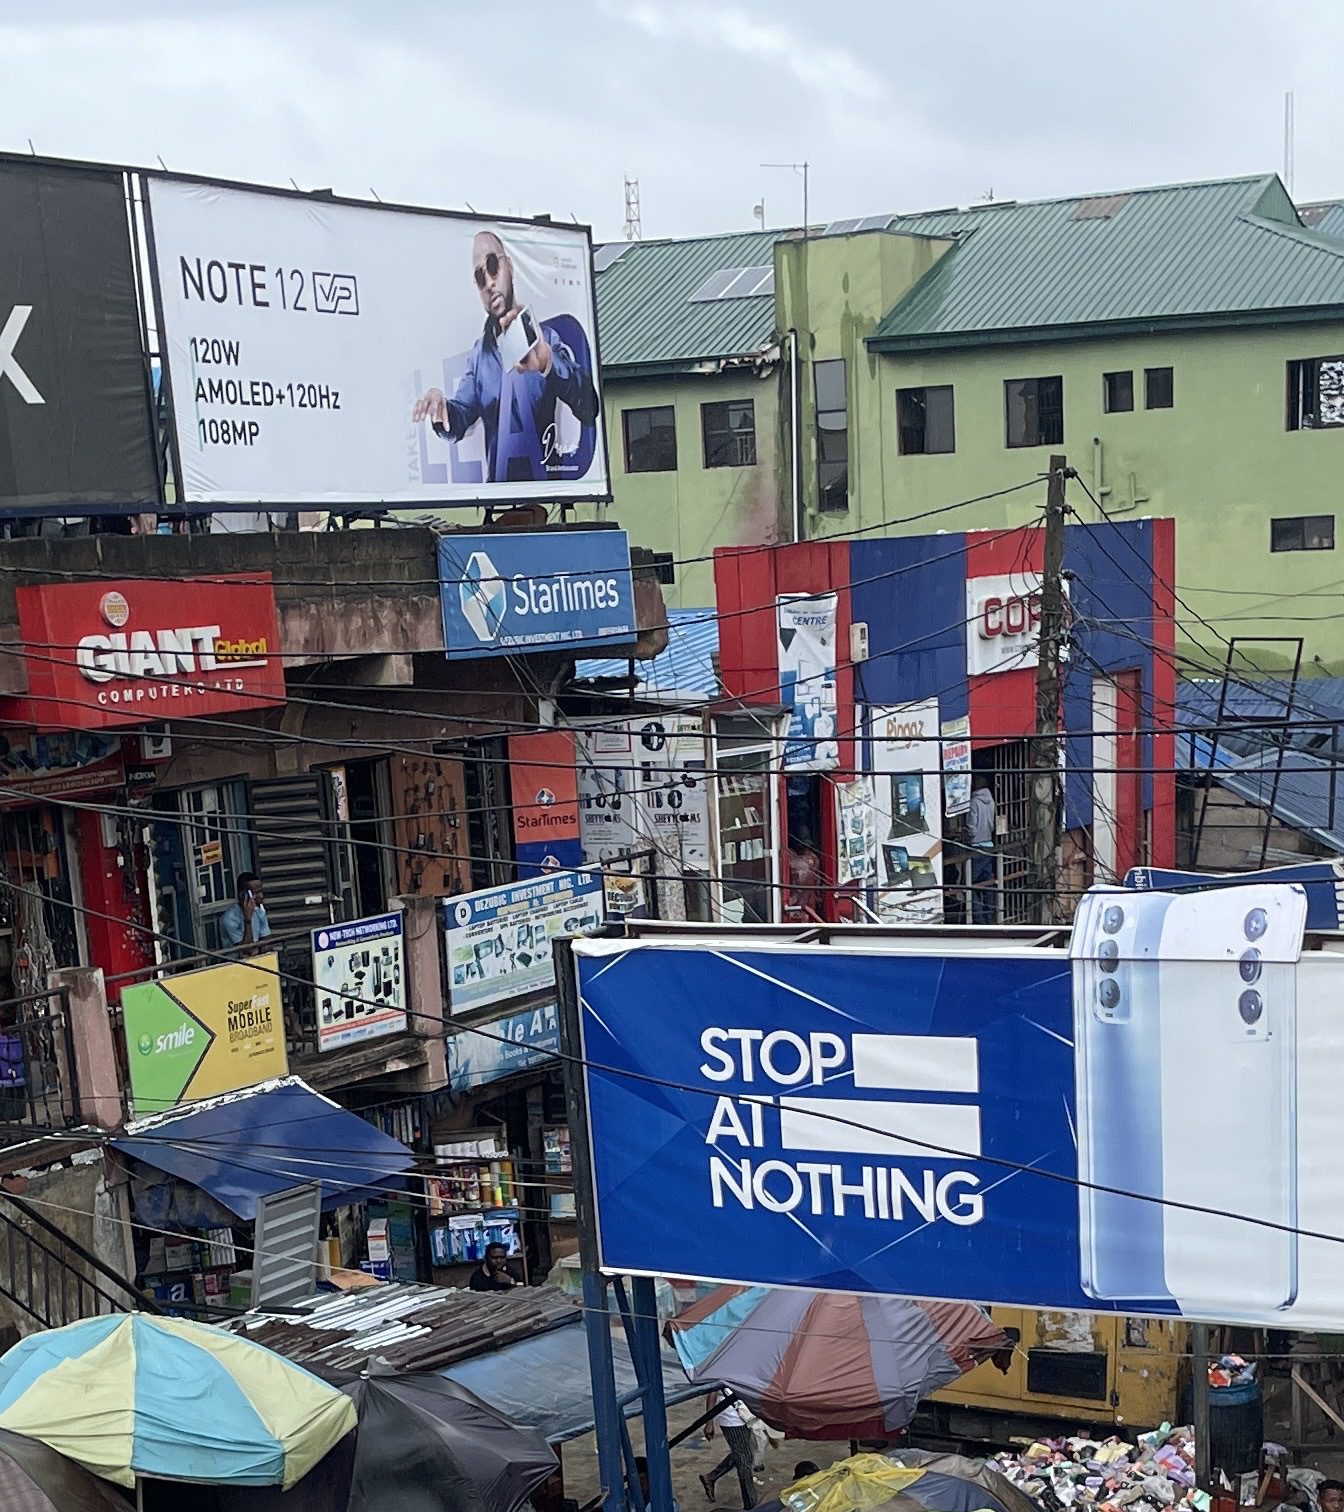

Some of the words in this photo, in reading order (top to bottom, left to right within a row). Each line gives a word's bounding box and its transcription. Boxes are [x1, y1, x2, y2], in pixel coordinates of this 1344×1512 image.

[179, 255, 266, 308] NOTE
[274, 268, 305, 312] 12
[190, 336, 241, 367] 120W
[194, 377, 342, 411] AMOLED+120Hz
[198, 419, 260, 447] 108MP
[511, 571, 620, 616] StarTimes
[792, 615, 828, 626] CENTRE
[76, 625, 222, 683] GIANT
[128, 771, 156, 782] NOKIA
[517, 812, 577, 829] StarTimes
[511, 882, 555, 903] INVESTMENT
[228, 1007, 272, 1032] MOBILE
[229, 1022, 273, 1043] BROADBAND
[155, 1022, 195, 1054] smile
[698, 1026, 846, 1086] STOP
[705, 1094, 776, 1149] AT
[709, 1156, 986, 1228] NOTHING
